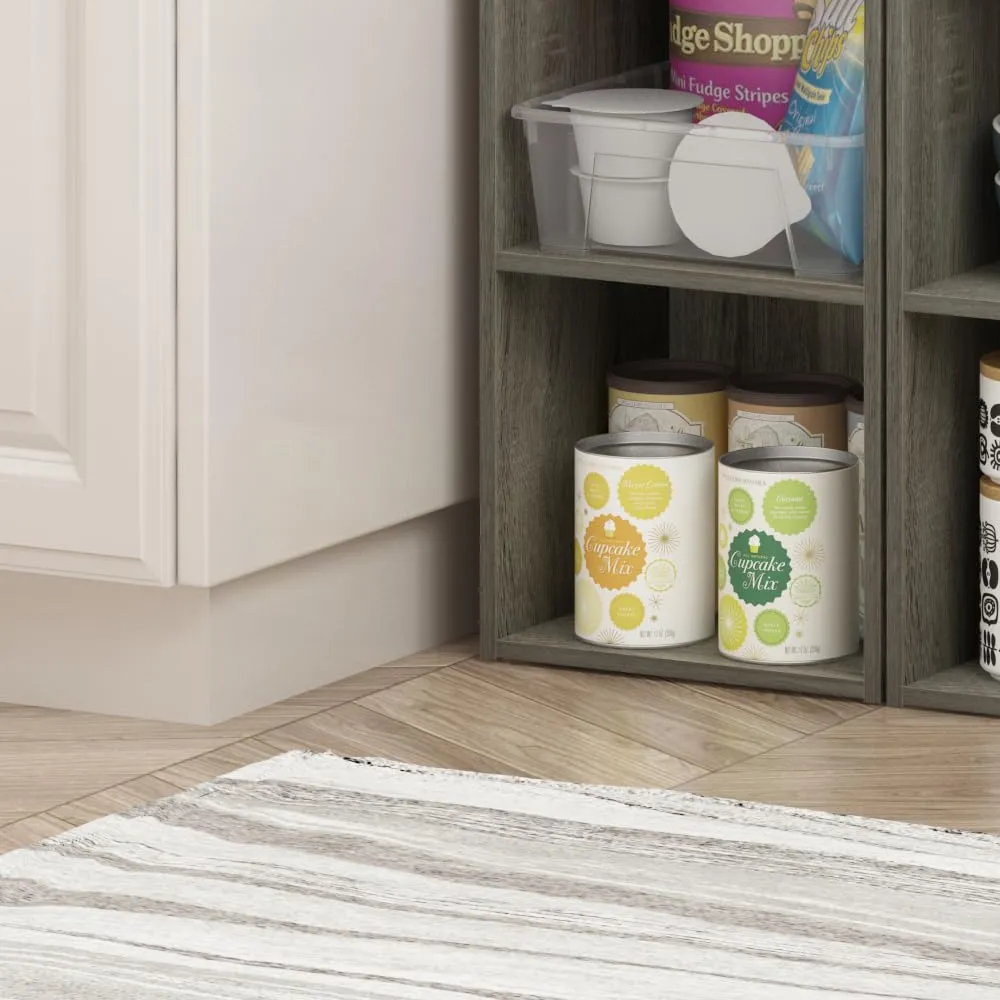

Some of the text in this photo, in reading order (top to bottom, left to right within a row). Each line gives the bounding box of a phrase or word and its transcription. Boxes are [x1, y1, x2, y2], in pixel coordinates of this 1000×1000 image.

[671, 15, 710, 54] dge
[689, 77, 730, 102] Fudge
[735, 84, 789, 109] Stripes
[585, 536, 641, 558] Cupcake
[600, 555, 634, 575] Mix
[730, 551, 786, 573] Cupcake
[742, 571, 779, 591] Mix
